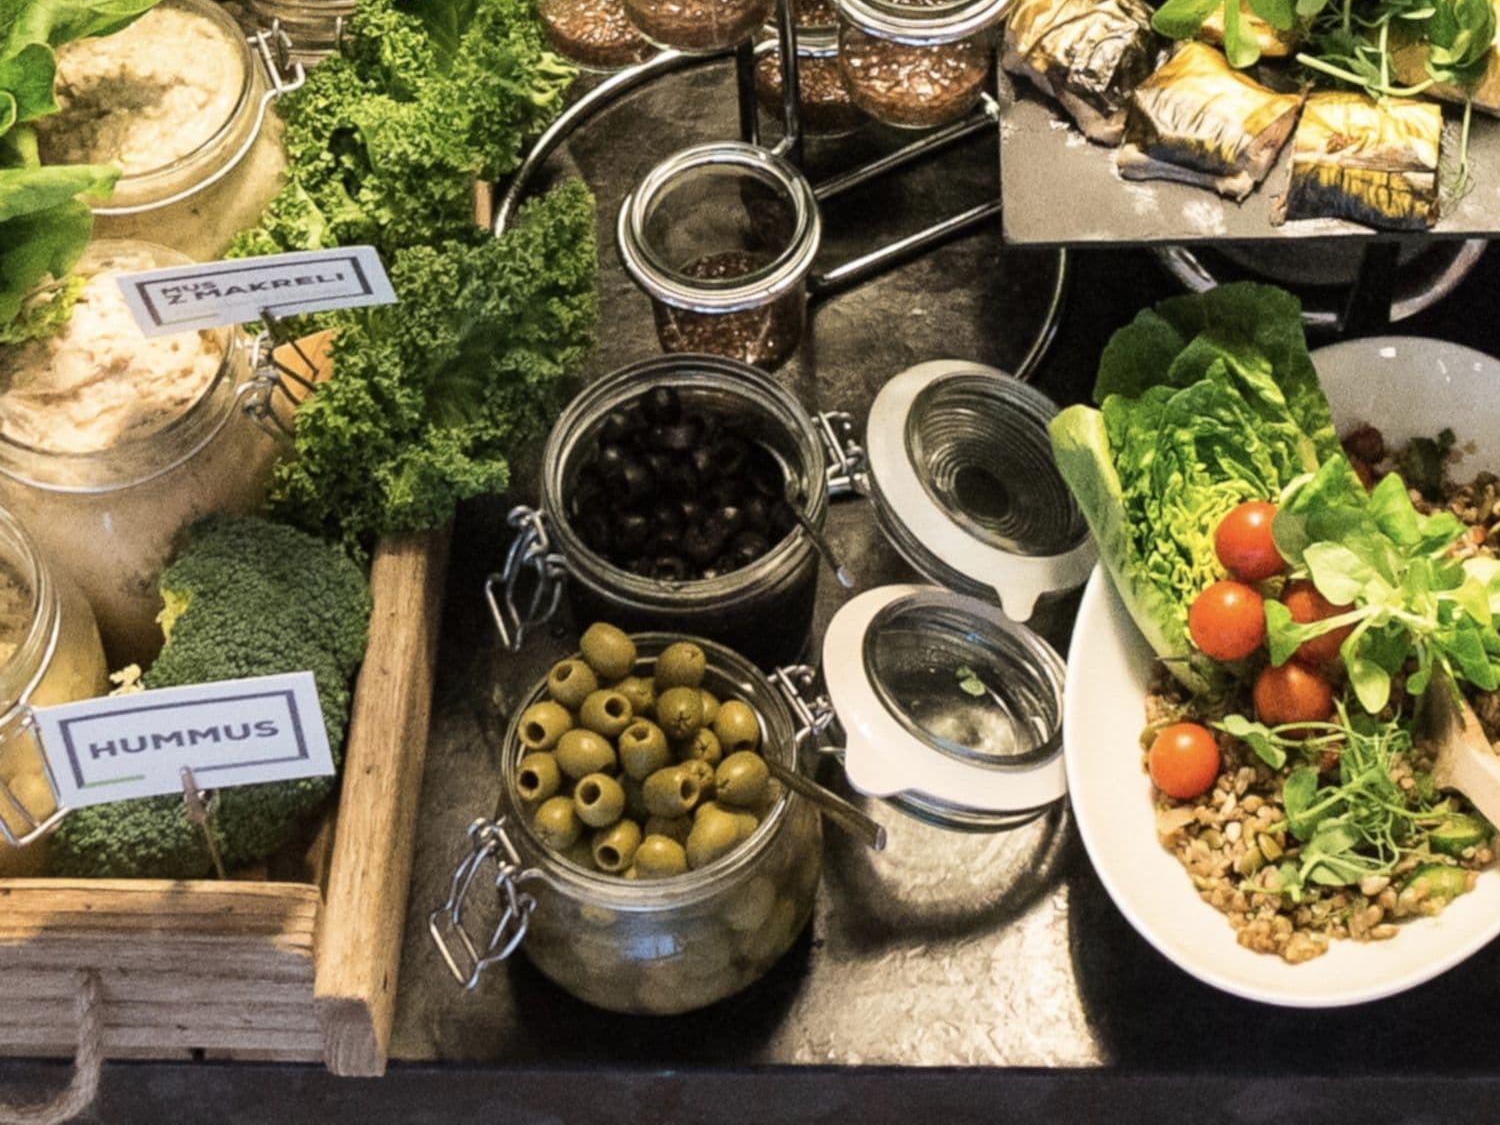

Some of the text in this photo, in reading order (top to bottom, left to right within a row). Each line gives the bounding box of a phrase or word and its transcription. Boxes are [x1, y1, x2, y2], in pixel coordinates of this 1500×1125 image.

[161, 280, 218, 296] MUS
[167, 294, 187, 305] Z
[197, 272, 345, 301] MAKRELI
[89, 720, 279, 760] HUMMUS
